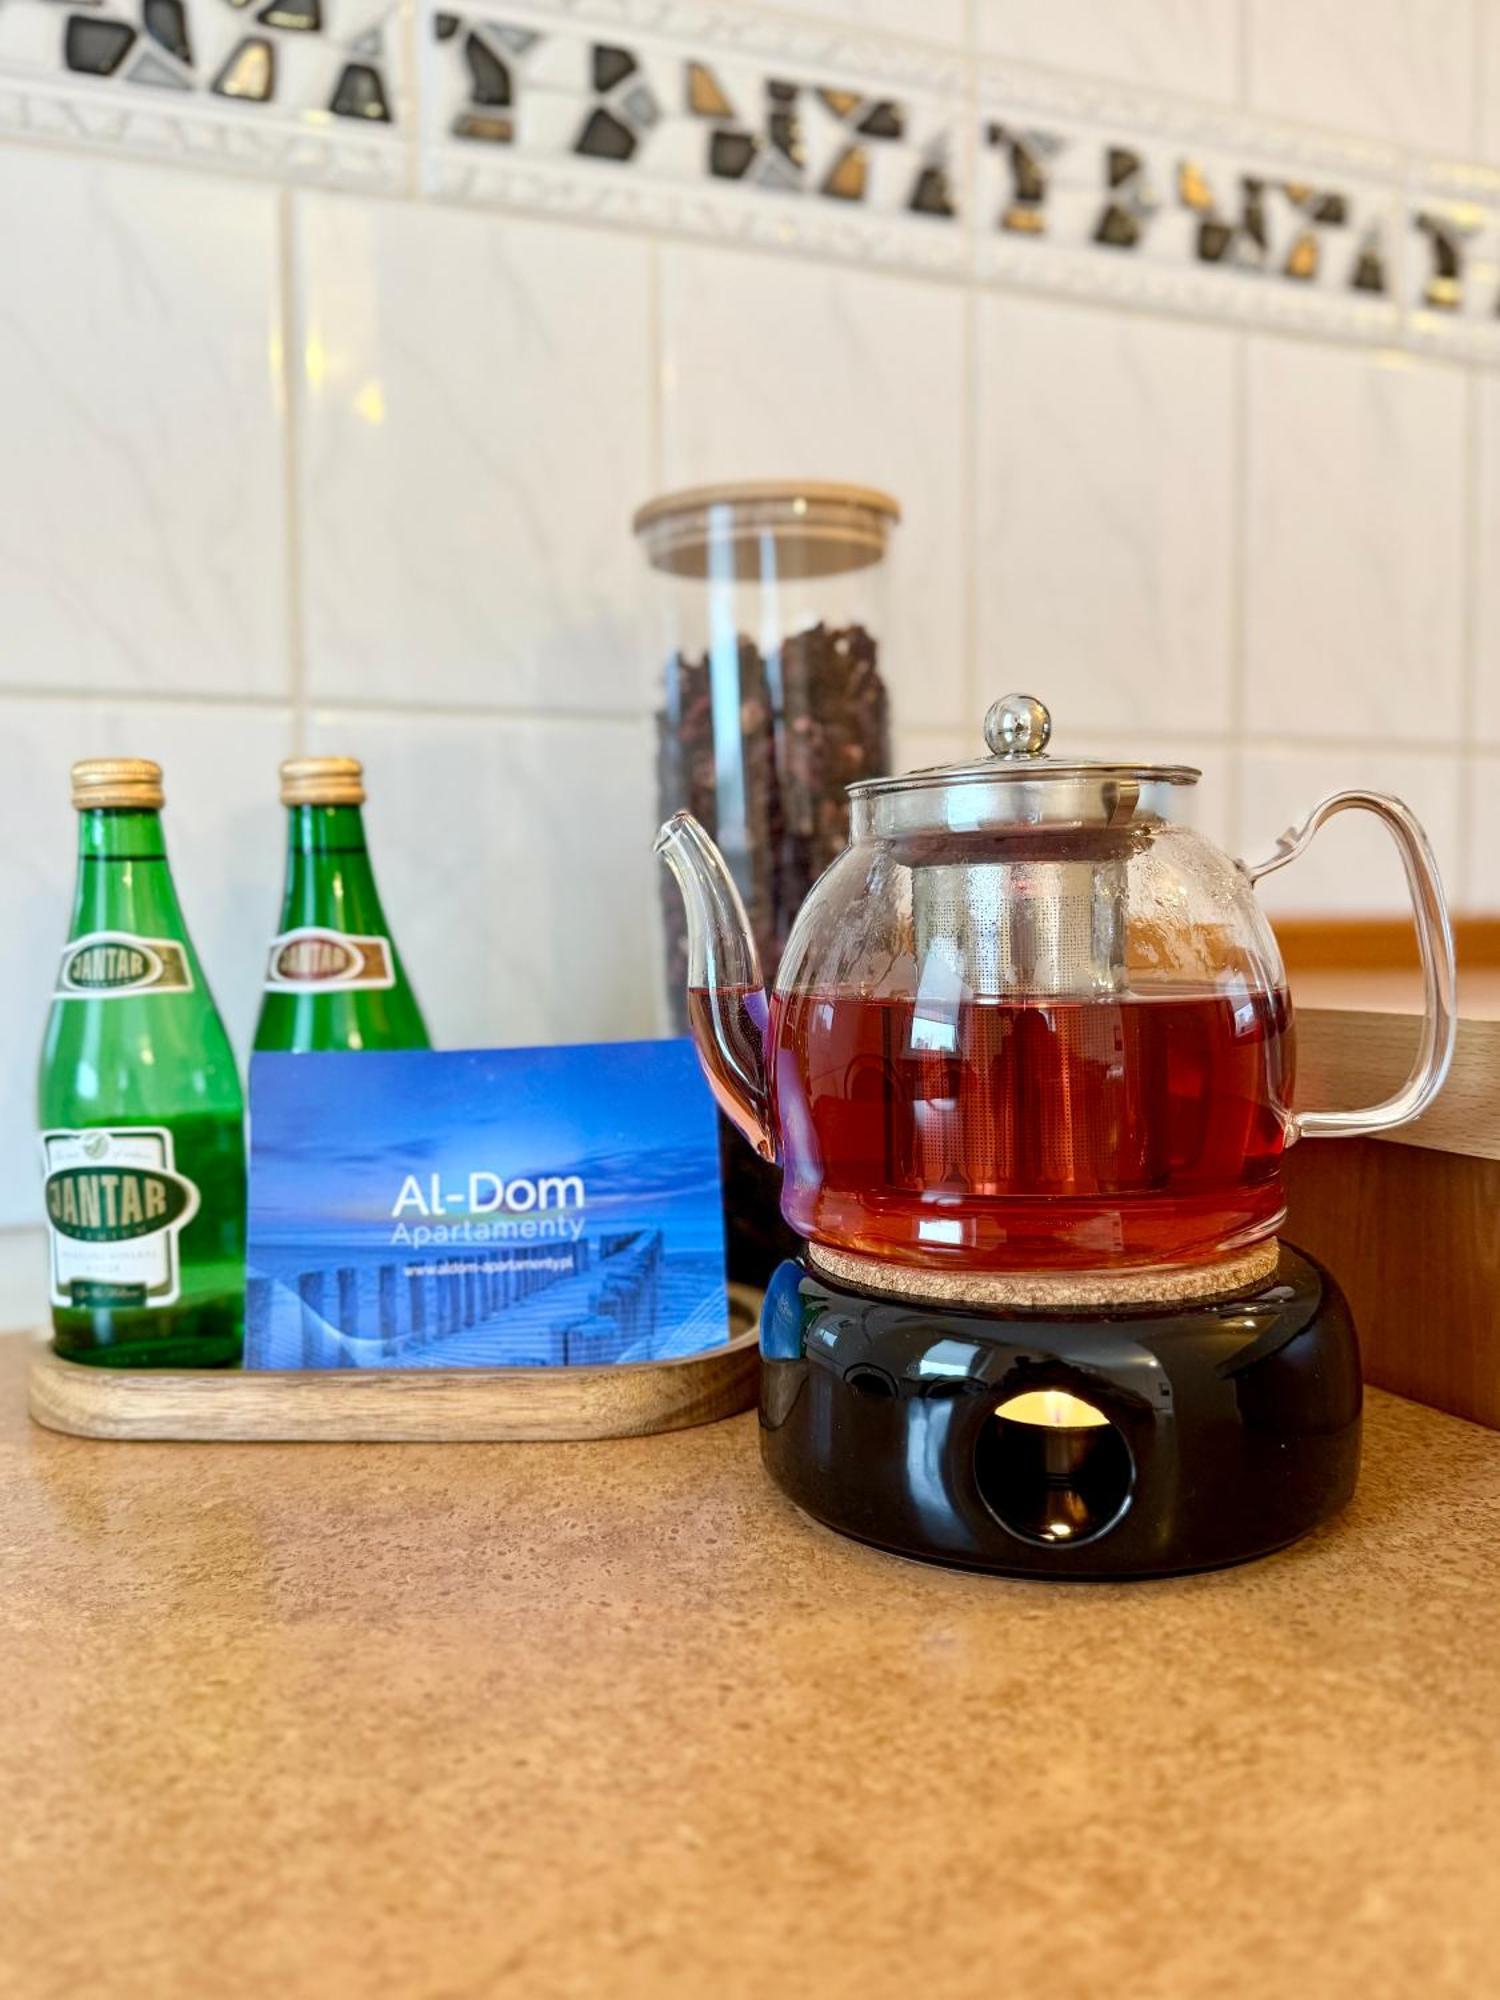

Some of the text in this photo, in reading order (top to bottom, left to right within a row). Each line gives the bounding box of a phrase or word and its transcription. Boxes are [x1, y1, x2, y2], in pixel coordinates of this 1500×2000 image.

[72, 948, 144, 980] JANTAR
[50, 1173, 167, 1228] JANTAR
[391, 1171, 585, 1218] Al-Dom
[390, 1214, 585, 1248] Apartamenty
